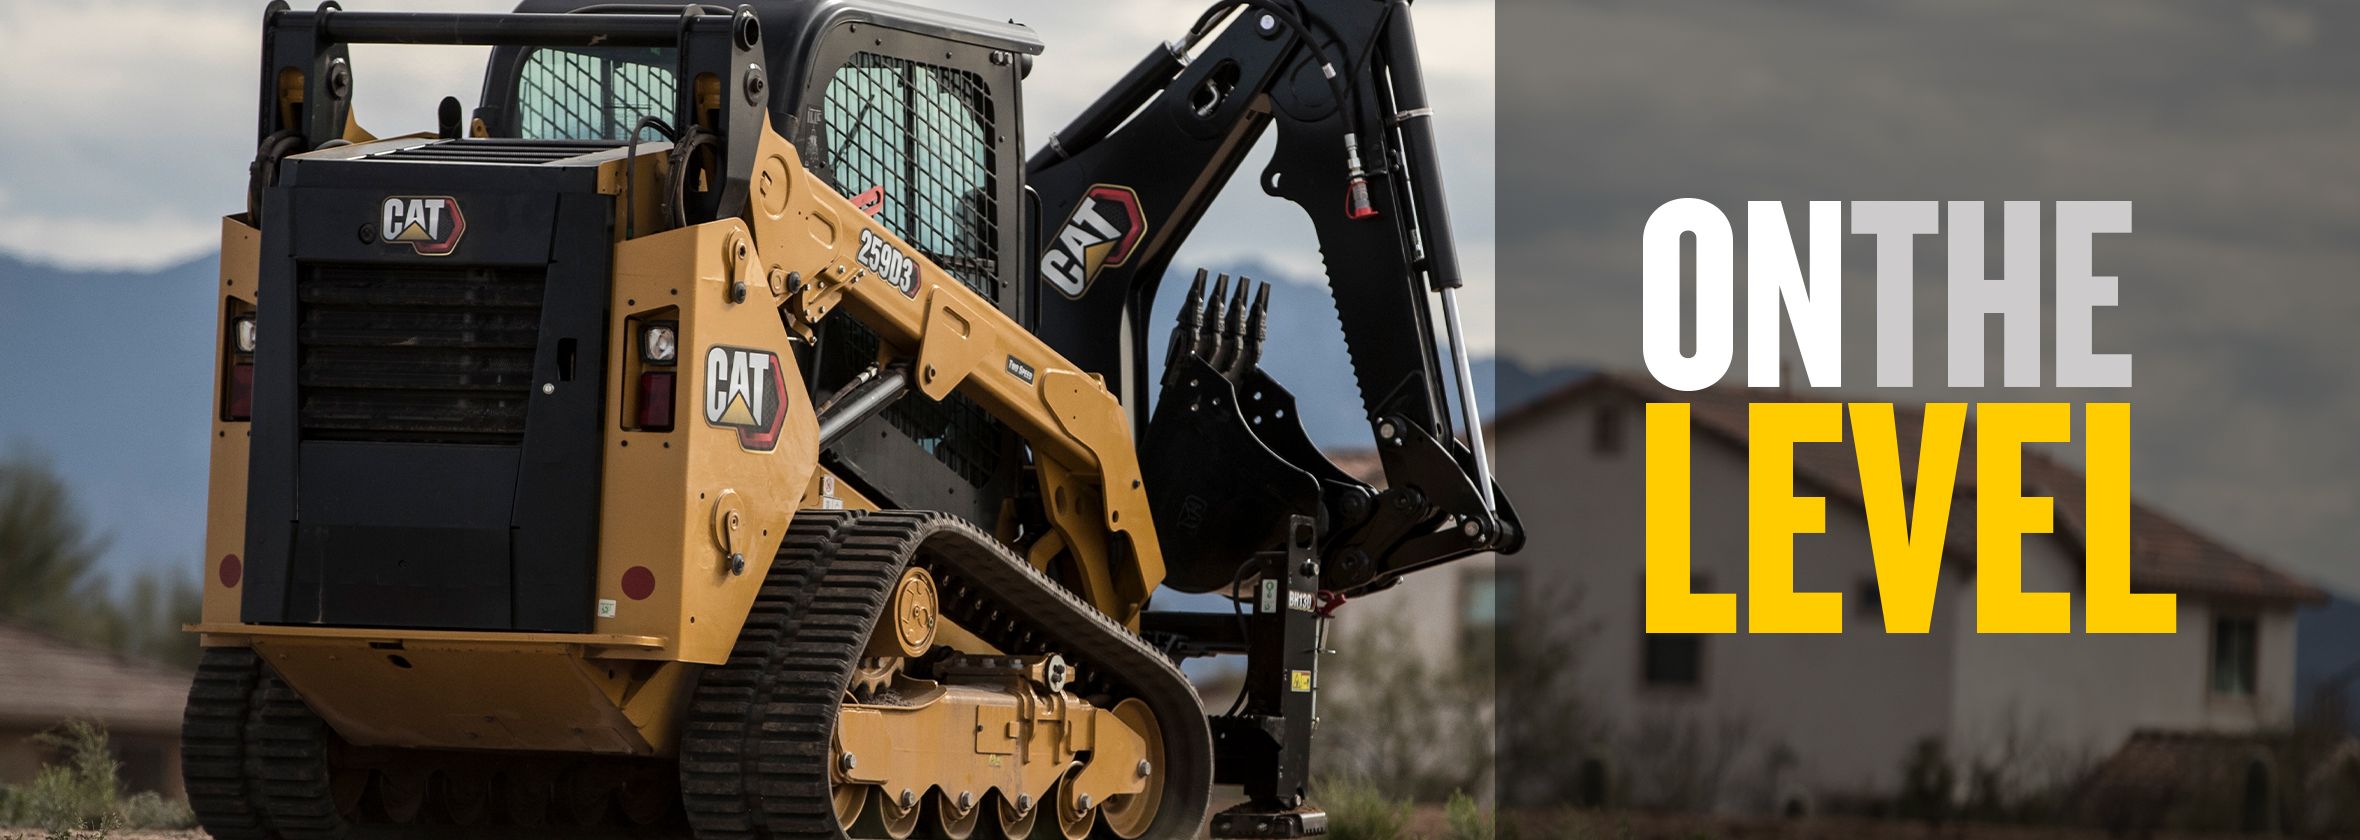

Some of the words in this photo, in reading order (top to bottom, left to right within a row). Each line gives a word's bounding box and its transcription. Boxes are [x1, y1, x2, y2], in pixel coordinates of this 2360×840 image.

[383, 198, 445, 241] CAT
[1040, 196, 1122, 295] CAT
[857, 229, 914, 293] 259D3
[706, 347, 770, 427] CAT
[1288, 590, 1312, 609] BH130
